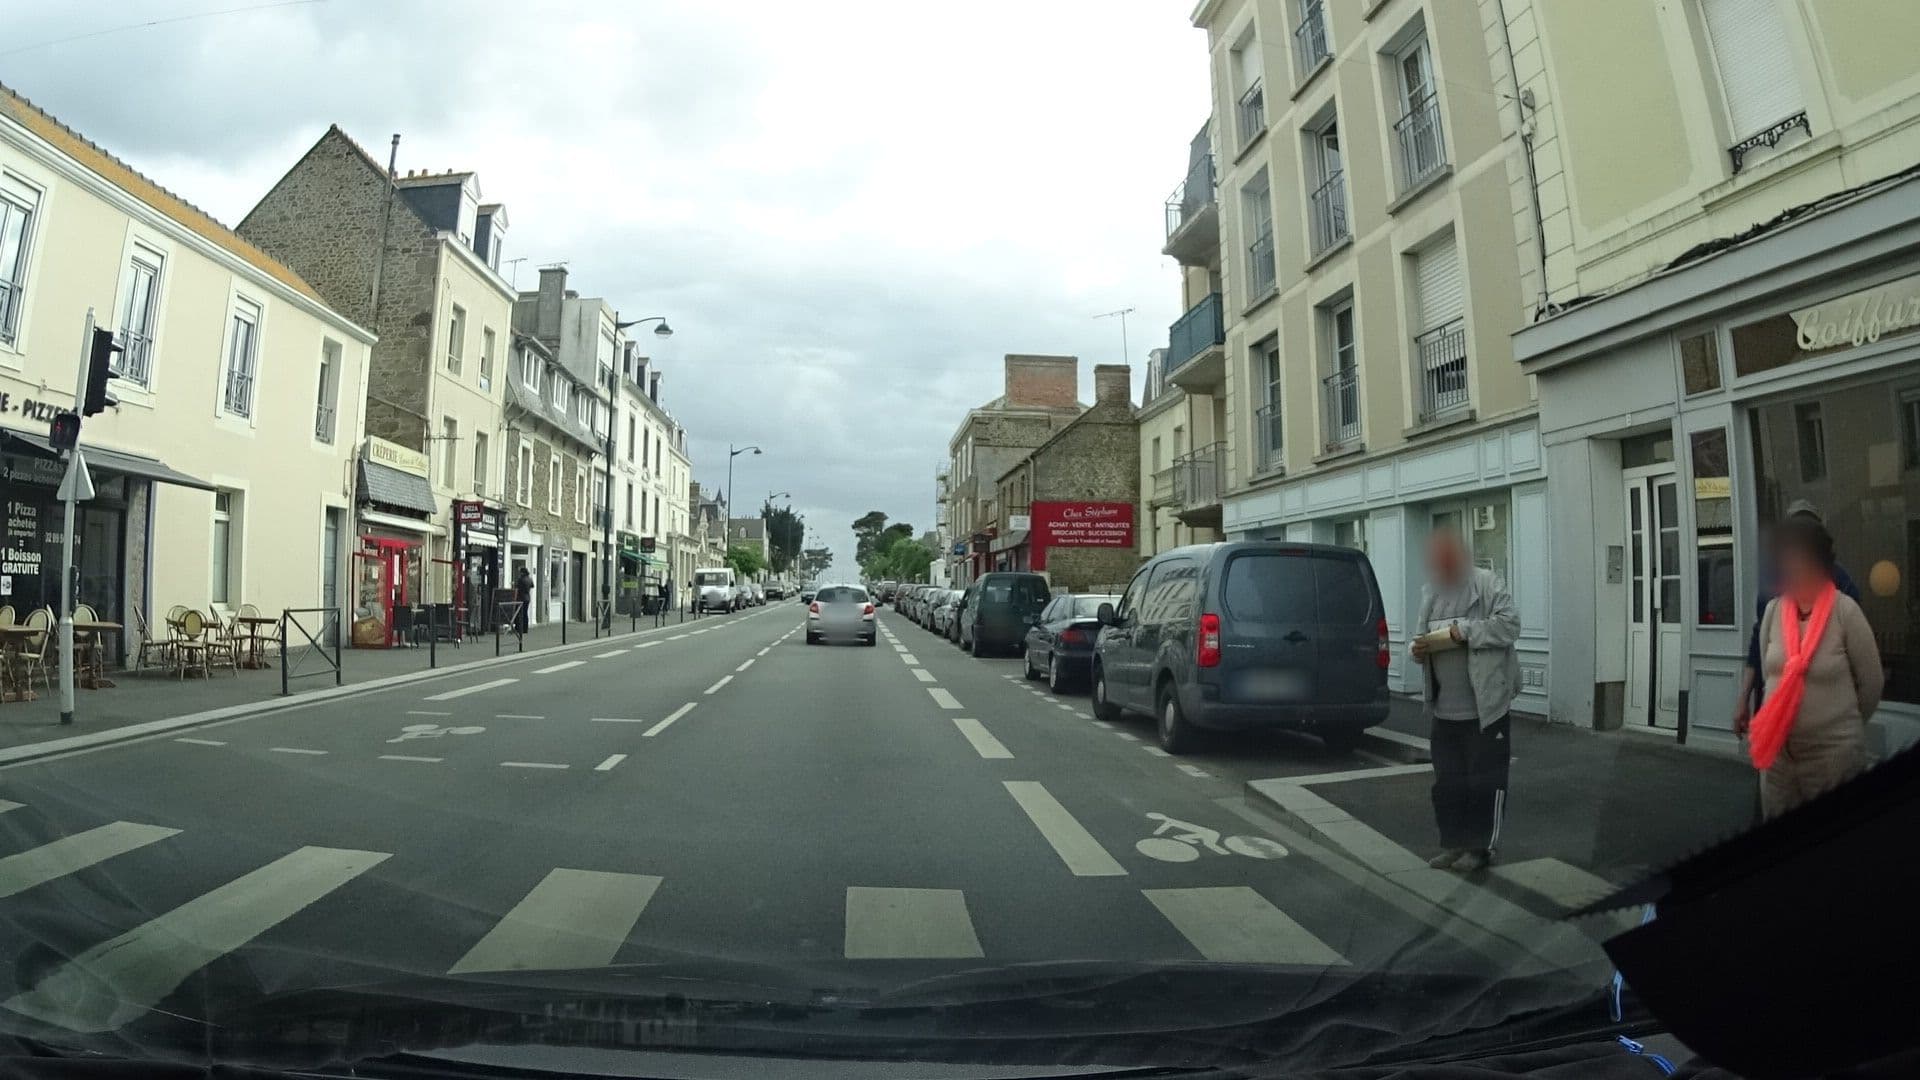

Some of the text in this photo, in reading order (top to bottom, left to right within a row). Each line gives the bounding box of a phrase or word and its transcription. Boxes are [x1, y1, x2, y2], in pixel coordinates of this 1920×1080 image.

[0, 391, 9, 413] E
[3, 467, 9, 478] 2
[7, 501, 37, 517] 1 Pizza
[0, 547, 42, 563] 1 Boisson
[2, 562, 39, 575] GRATUITE
